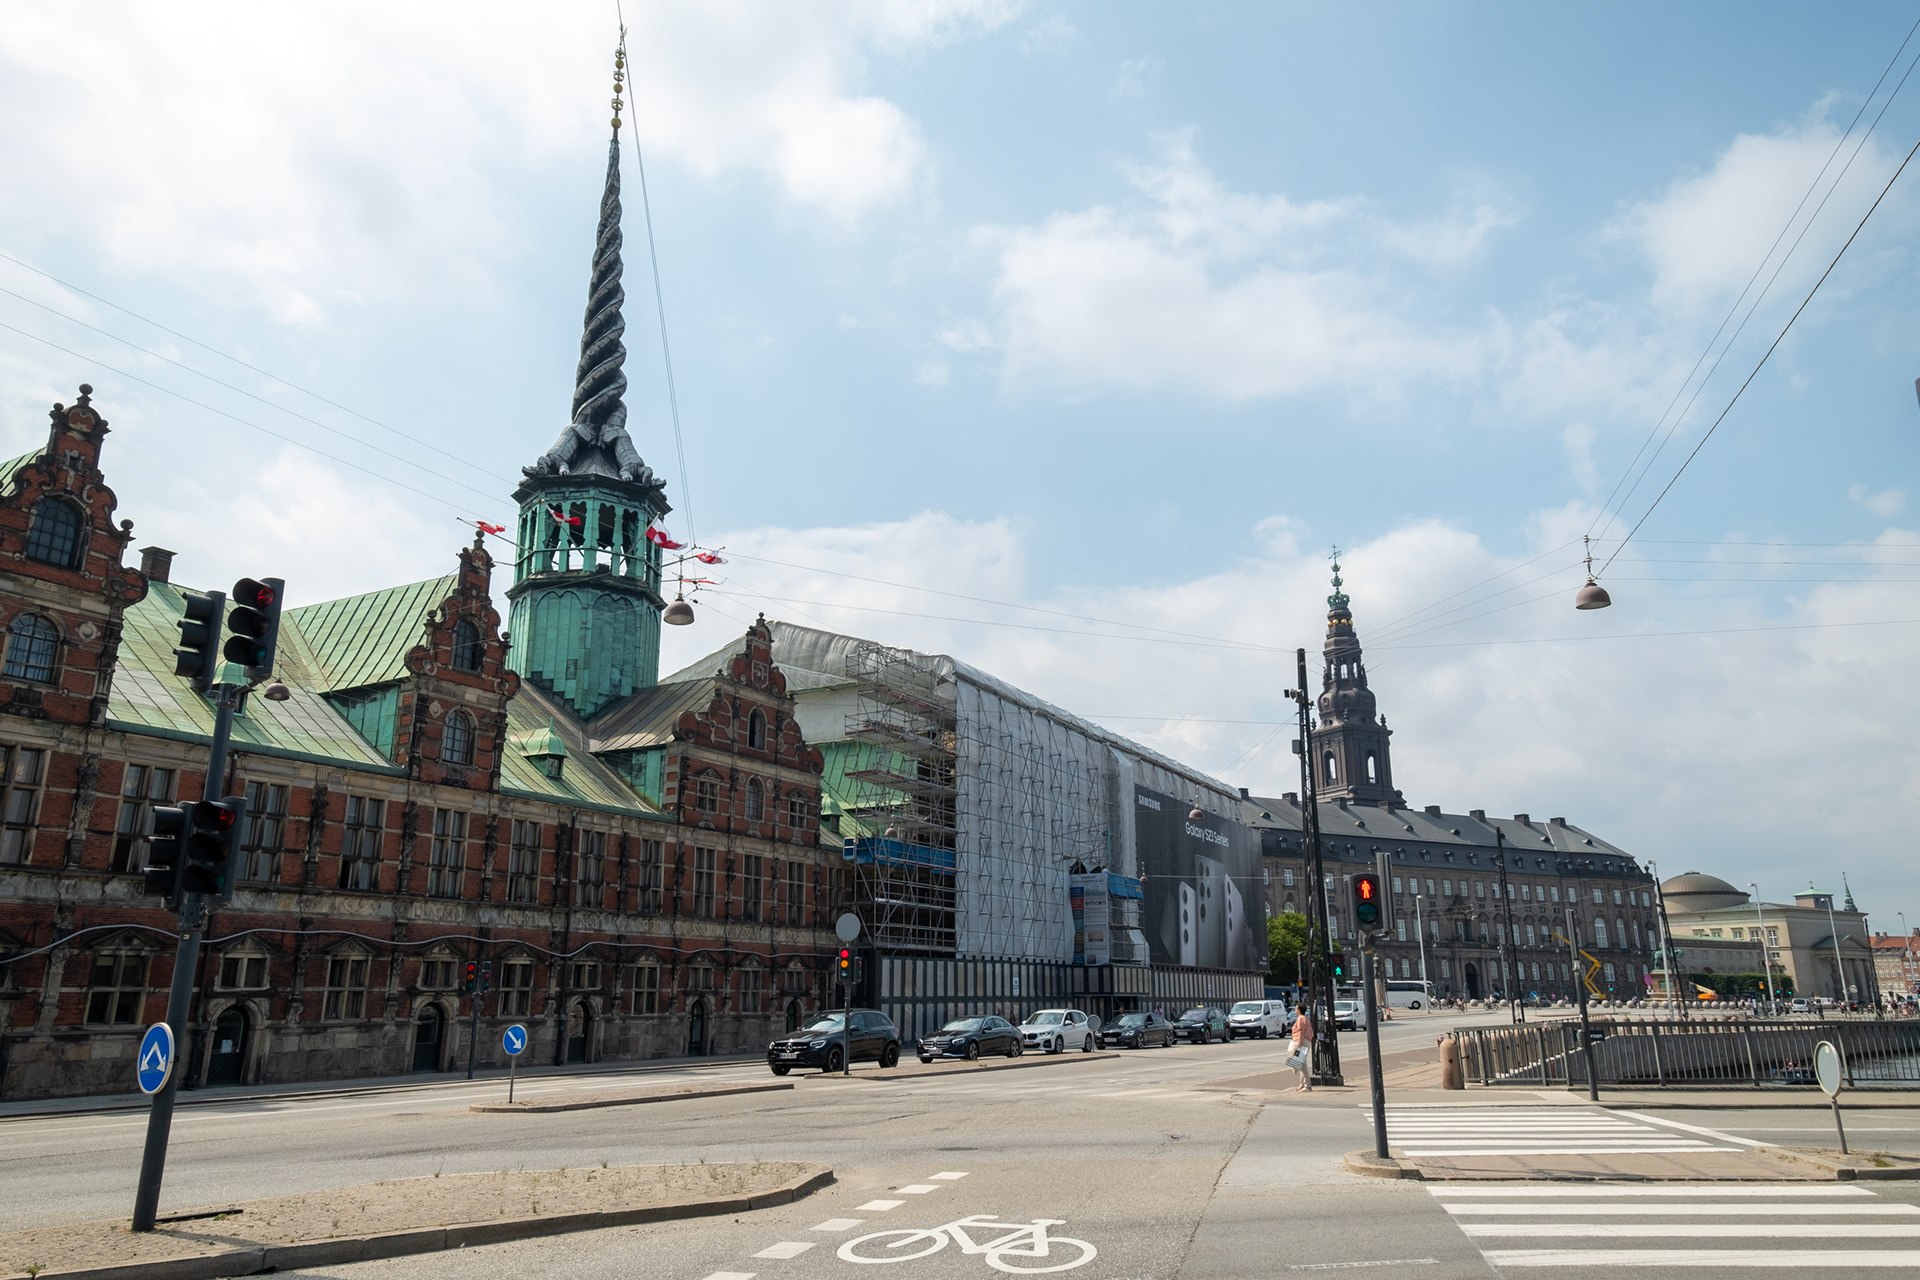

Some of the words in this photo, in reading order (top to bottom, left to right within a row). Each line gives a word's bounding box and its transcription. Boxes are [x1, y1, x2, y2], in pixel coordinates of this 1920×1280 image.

[1138, 795, 1161, 811] SAMSUNG
[1185, 821, 1204, 842] Galaxy
[1204, 828, 1214, 843] S23
[1213, 832, 1229, 847] Series
